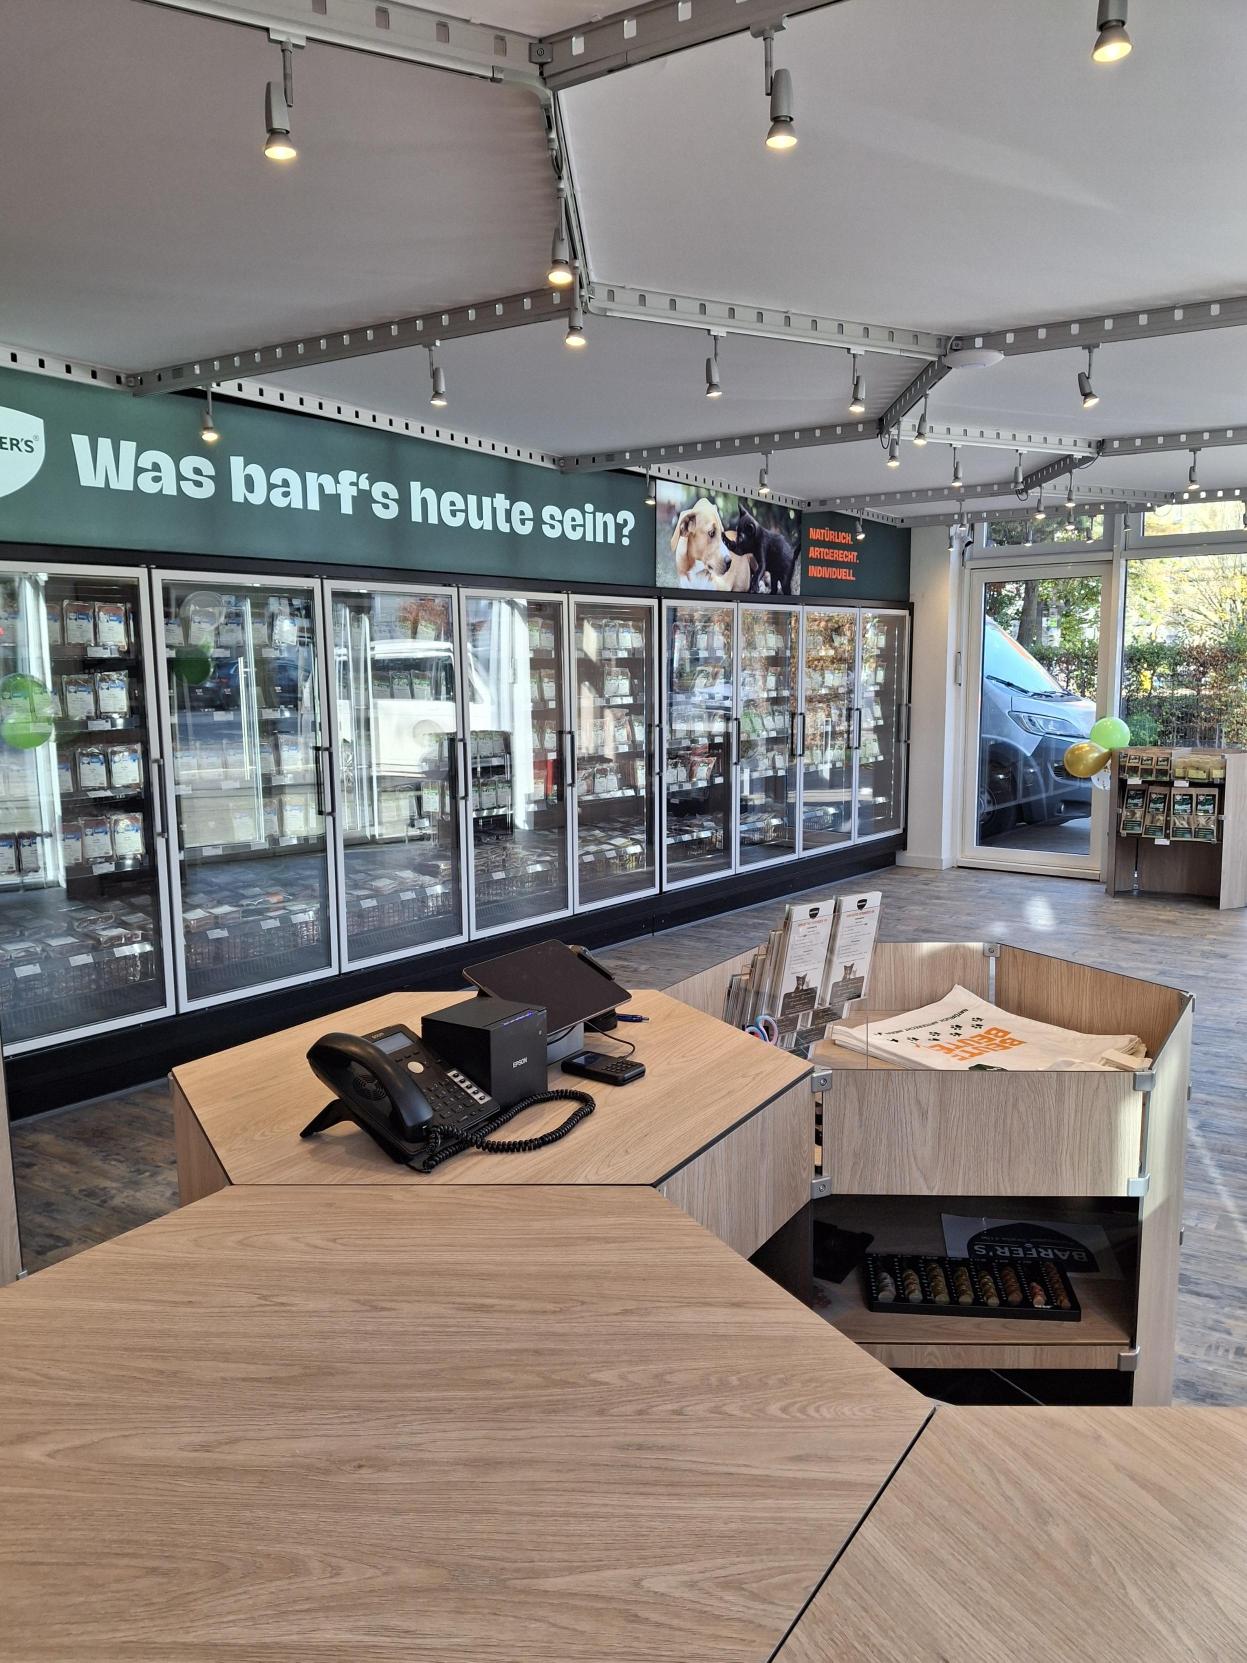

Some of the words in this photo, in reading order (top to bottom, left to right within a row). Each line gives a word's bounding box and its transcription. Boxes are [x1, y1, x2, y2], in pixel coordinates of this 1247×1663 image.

[70, 433, 216, 499] Was
[410, 481, 534, 536] heute
[541, 503, 636, 546] sein?
[809, 527, 853, 544] NATÜRLICH.
[809, 547, 859, 563] ARTGERECHT.
[808, 564, 856, 580] INDIVIDUELL.
[512, 1056, 528, 1069] EPSON
[973, 1244, 1089, 1262] BARFER'S
